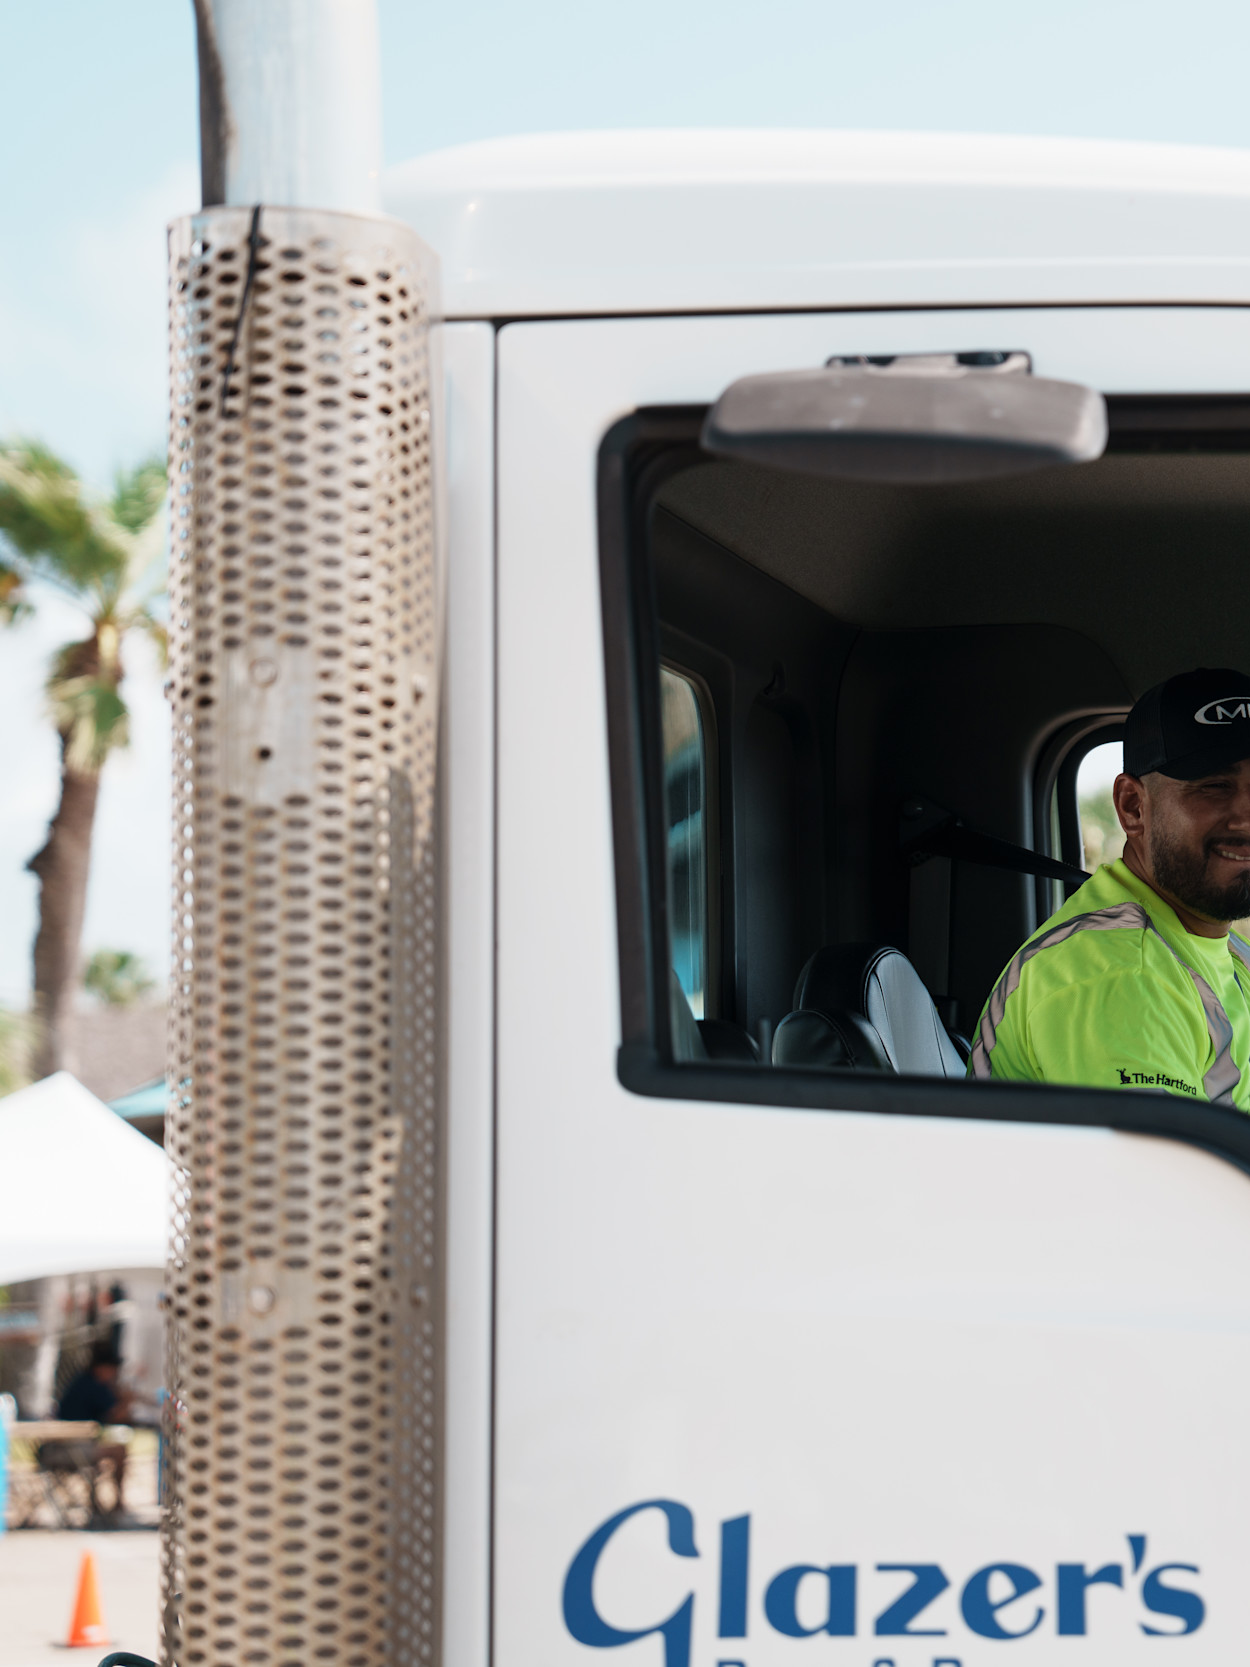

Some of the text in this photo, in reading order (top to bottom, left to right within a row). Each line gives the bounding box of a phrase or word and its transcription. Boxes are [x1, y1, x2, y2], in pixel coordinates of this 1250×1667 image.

[1132, 1073, 1197, 1096] The Hartford
[561, 1498, 1206, 1667] Glazer's
